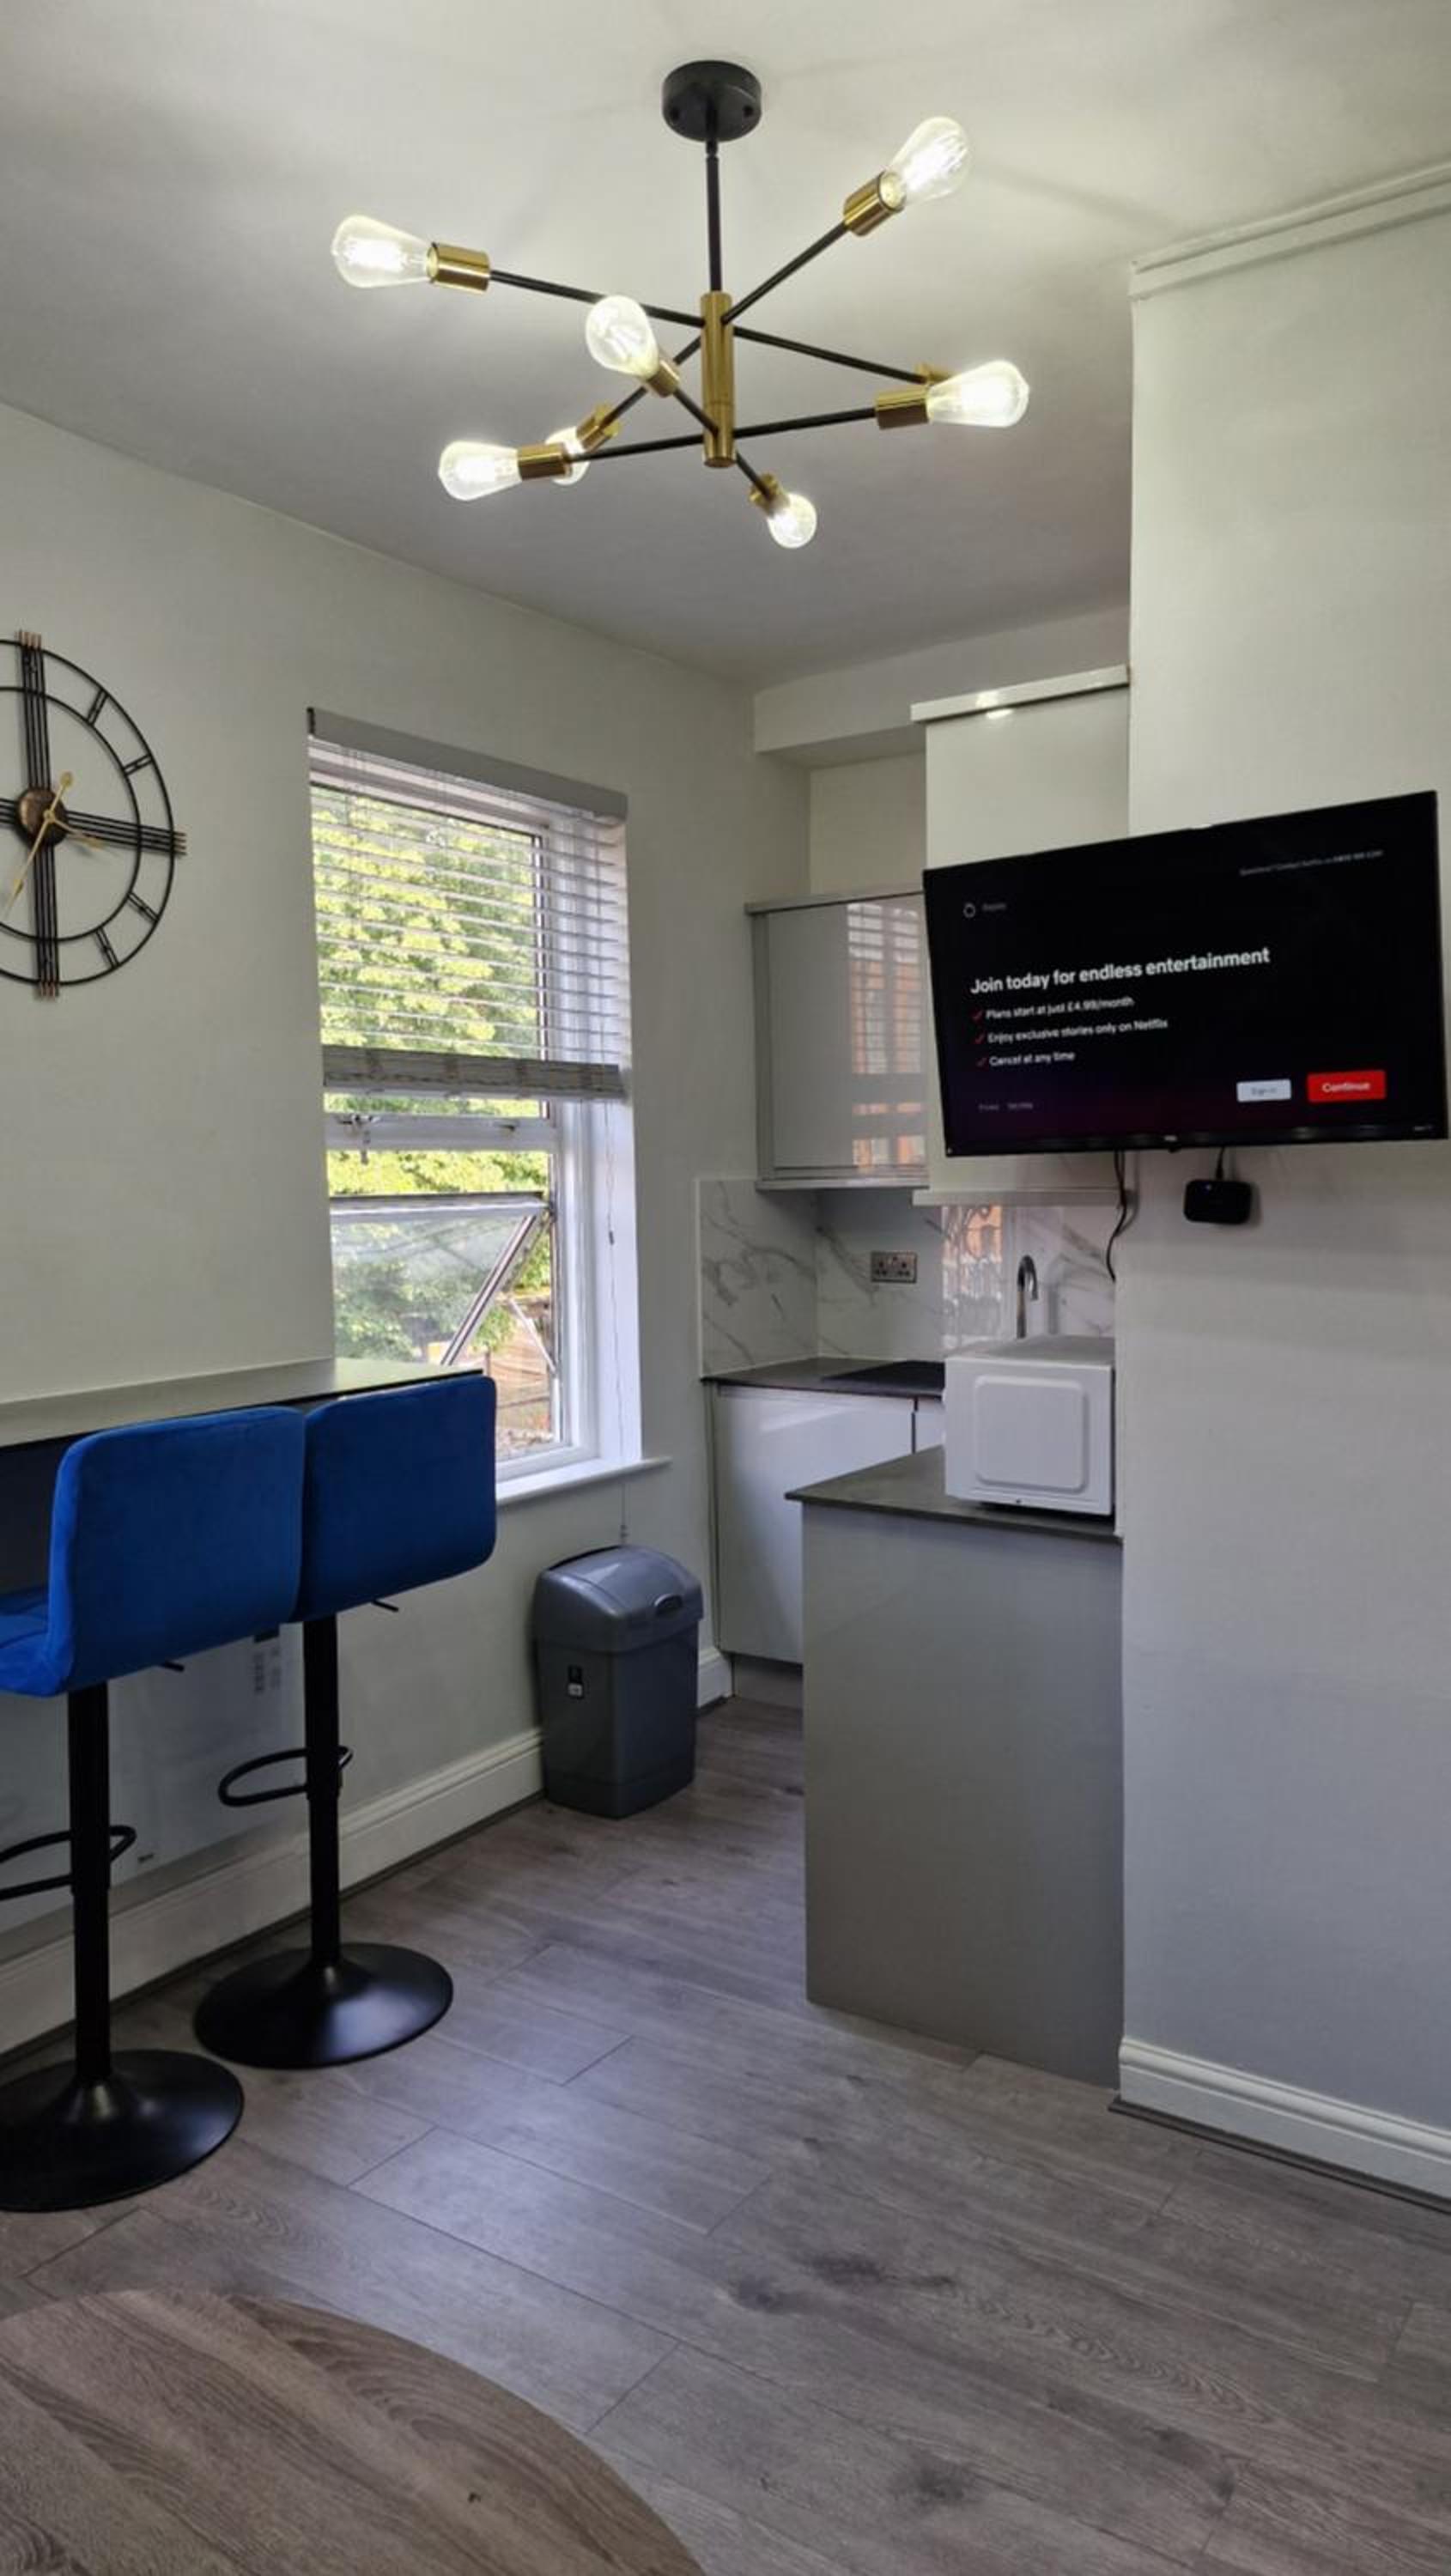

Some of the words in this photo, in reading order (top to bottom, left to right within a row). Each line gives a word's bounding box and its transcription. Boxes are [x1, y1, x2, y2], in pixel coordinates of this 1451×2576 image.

[970, 976, 1004, 994] Join
[1006, 972, 1050, 990] today
[1053, 969, 1076, 985] for
[1078, 963, 1143, 982] endless
[1145, 947, 1271, 975] entertainment
[986, 1007, 1012, 1020] Plans
[1013, 1005, 1035, 1018] start
[1037, 1005, 1047, 1015] at
[988, 1032, 1014, 1044] Enjoy
[1015, 1029, 1059, 1042] exclusive
[1061, 1025, 1094, 1037] stories
[1096, 1022, 1117, 1035] only
[1118, 1022, 1132, 1032] on
[1133, 1018, 1169, 1030] Netflix
[989, 1054, 1023, 1067] Cancel
[1023, 1053, 1034, 1065] at
[1035, 1053, 1052, 1065] any
[1053, 1050, 1076, 1062] time
[1321, 1080, 1371, 1094] Continue
